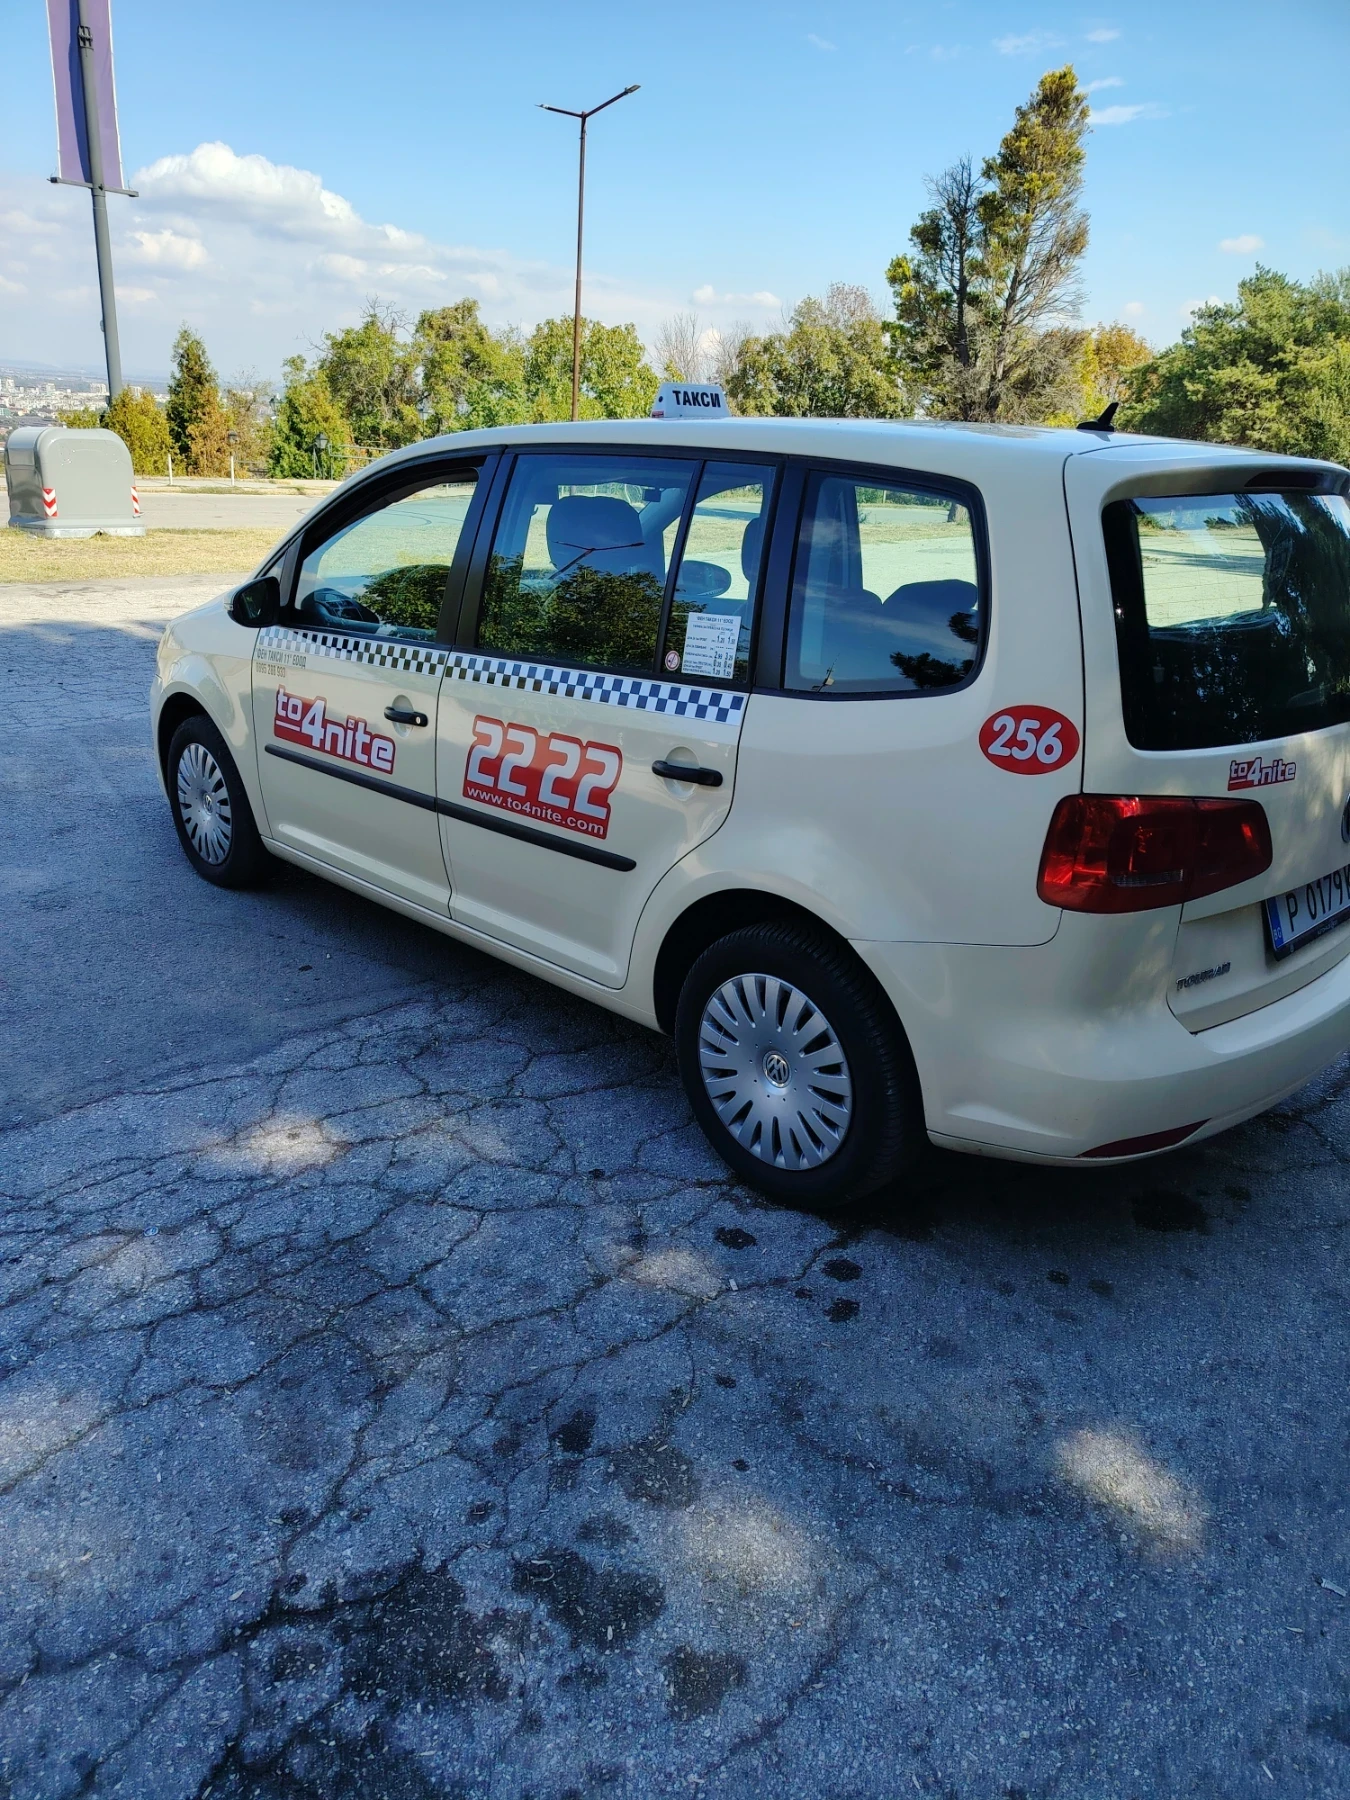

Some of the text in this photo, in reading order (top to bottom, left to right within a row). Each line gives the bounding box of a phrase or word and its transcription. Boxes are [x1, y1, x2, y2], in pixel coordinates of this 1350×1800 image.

[672, 390, 721, 408] ТАКСИ
[277, 687, 394, 771] to4nite
[988, 714, 1063, 764] 256
[1230, 757, 1296, 786] to4nite
[467, 786, 604, 835] www.to4nite.com
